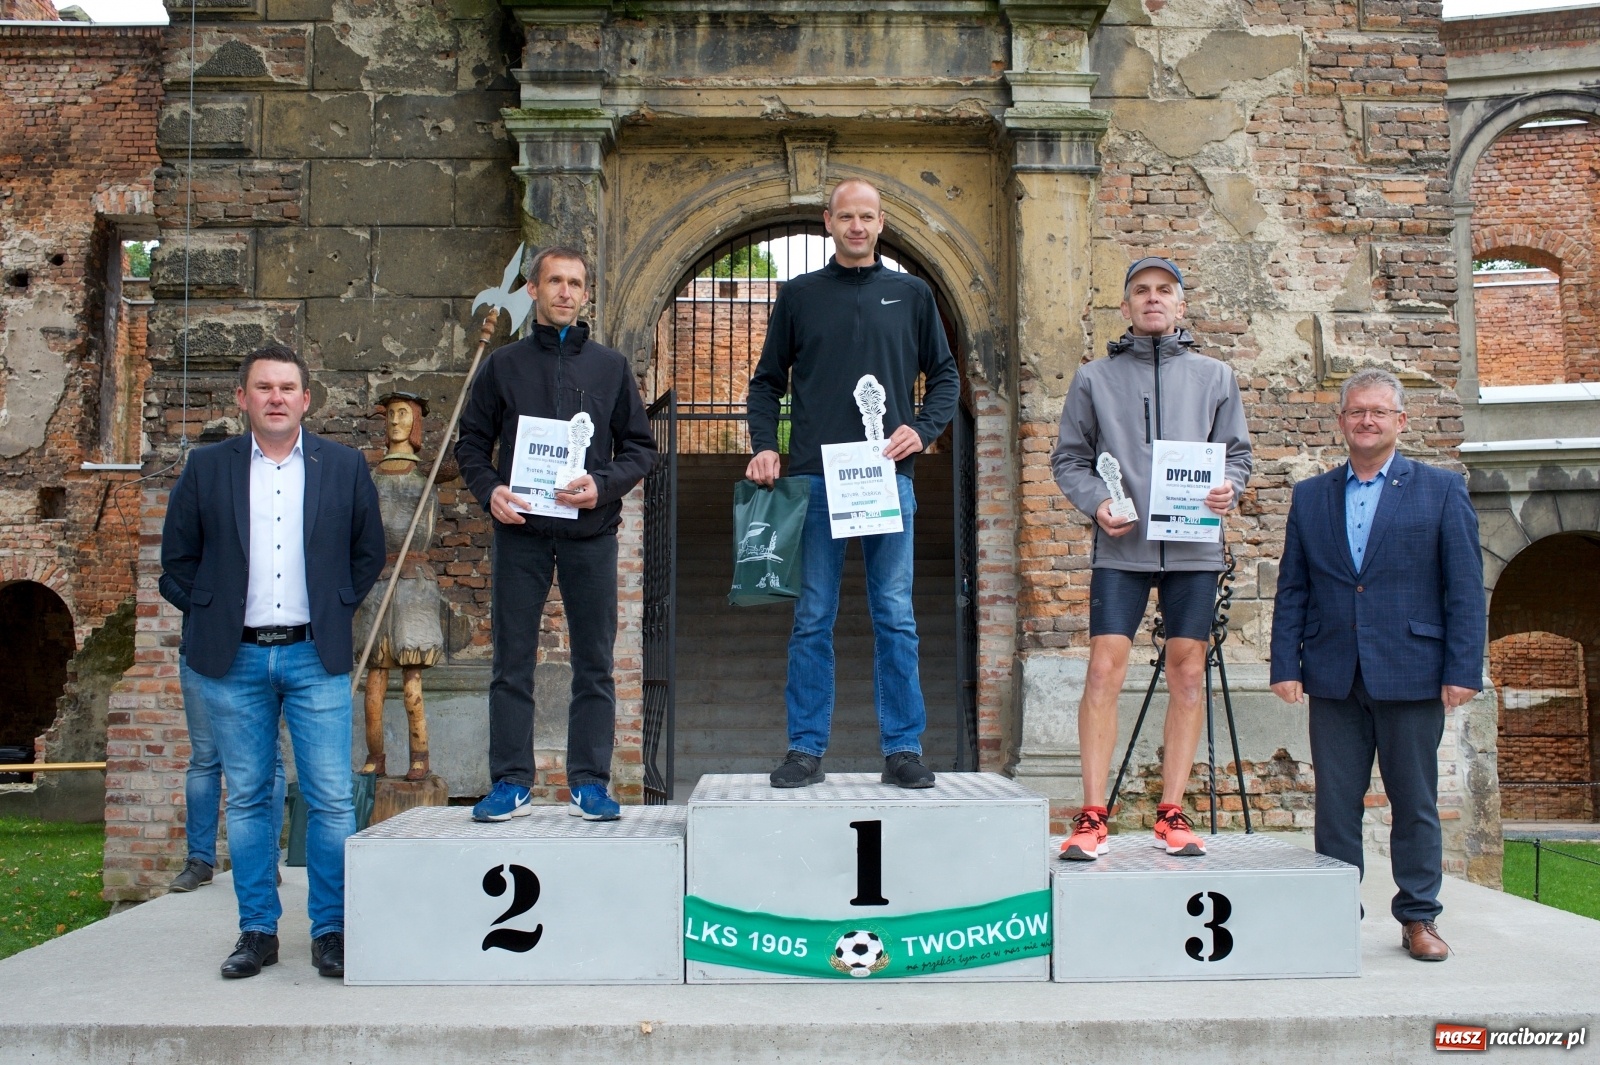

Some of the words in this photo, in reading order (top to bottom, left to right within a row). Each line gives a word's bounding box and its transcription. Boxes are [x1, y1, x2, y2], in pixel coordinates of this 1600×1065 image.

[838, 465, 883, 481] DYPLOM
[1166, 468, 1212, 483] DYPLOM
[849, 820, 889, 906] 1
[482, 864, 543, 953] 2
[685, 917, 738, 947] LKS
[748, 931, 808, 957] 1905
[901, 911, 1049, 957] TWORKÓW
[1185, 891, 1233, 962] 3
